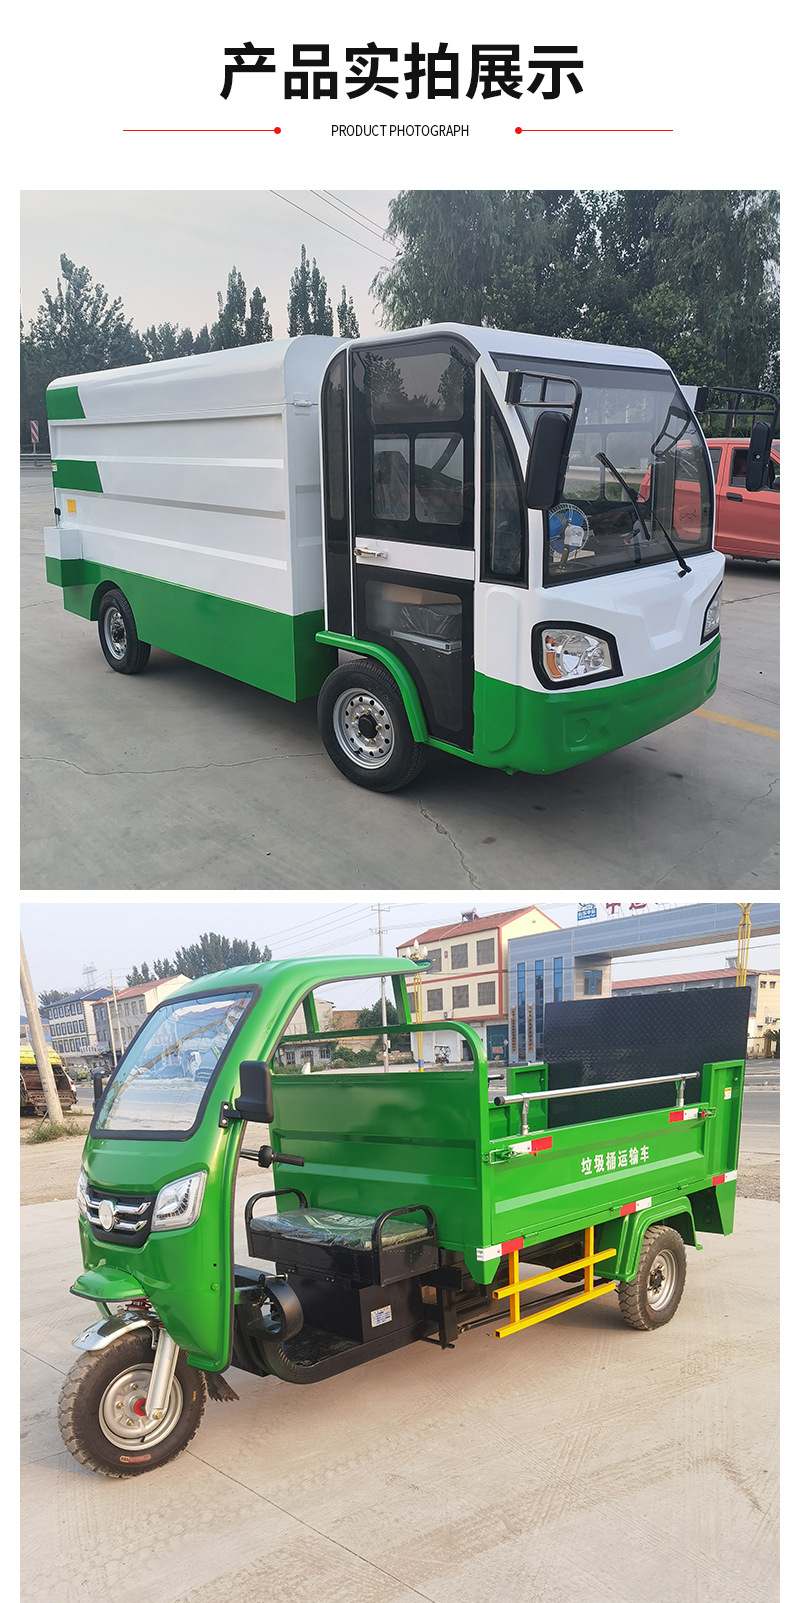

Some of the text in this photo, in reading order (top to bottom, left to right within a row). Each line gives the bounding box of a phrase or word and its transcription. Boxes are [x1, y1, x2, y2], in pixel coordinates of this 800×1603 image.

[581, 1145, 649, 1175] 垃圾桶运输车
